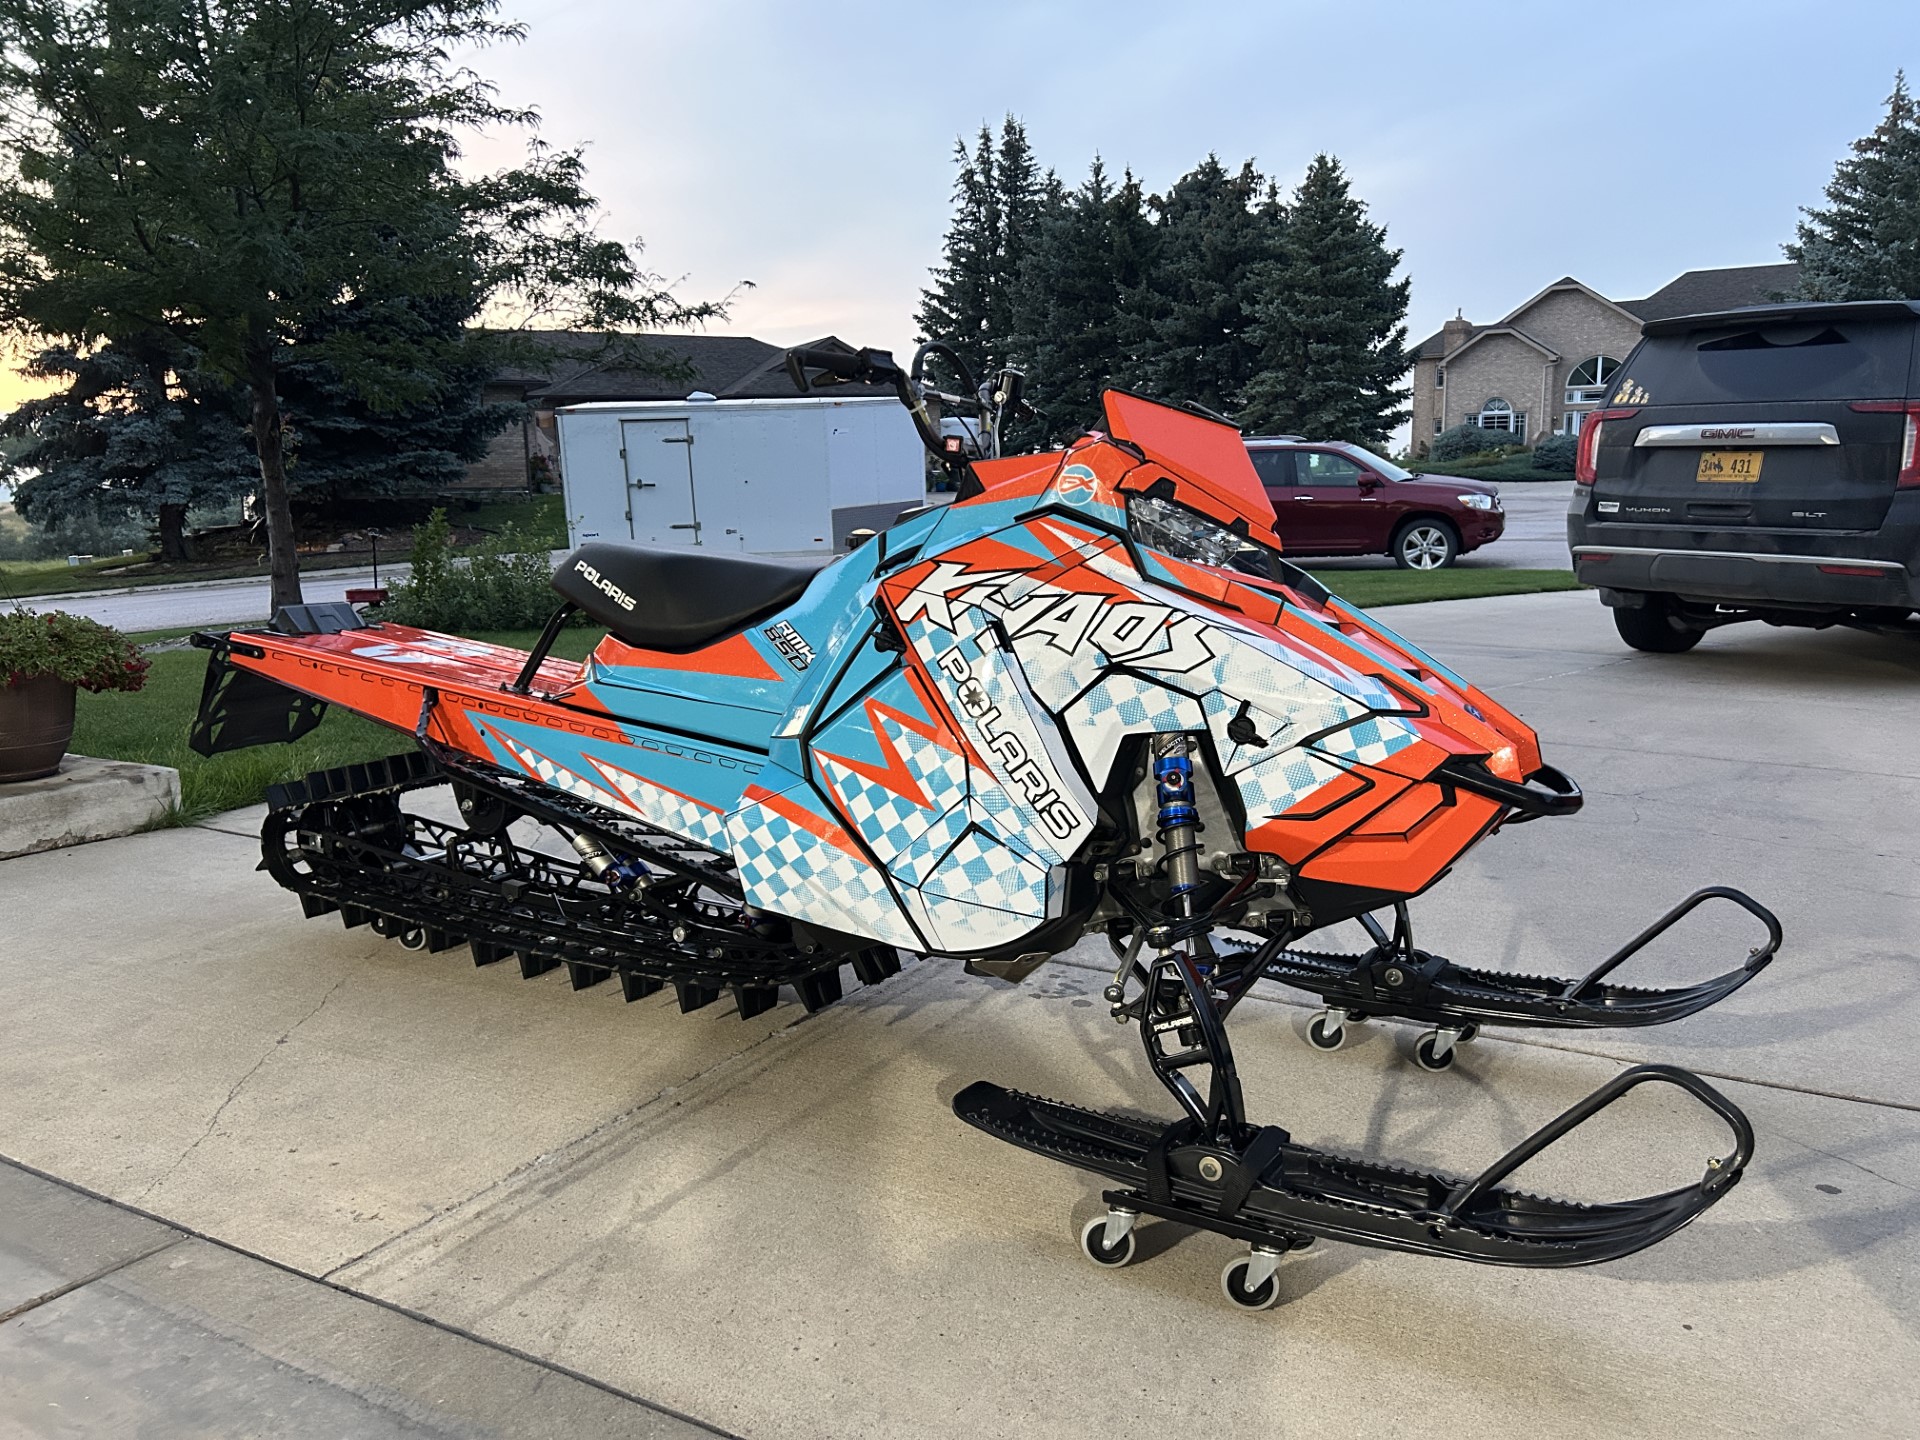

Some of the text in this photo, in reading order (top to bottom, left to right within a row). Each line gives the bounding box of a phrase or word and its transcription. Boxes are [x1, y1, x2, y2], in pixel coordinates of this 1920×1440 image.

[1700, 428, 1756, 439] GMC
[1730, 459, 1751, 473] 431
[574, 560, 637, 611] POLARIS
[895, 559, 1216, 674] KHAOS
[763, 626, 809, 672] 850
[774, 619, 817, 665] RMK
[937, 645, 1081, 840] POLARIS
[1158, 735, 1184, 756] VELOCITY
[1153, 1015, 1194, 1032] POLARIS
